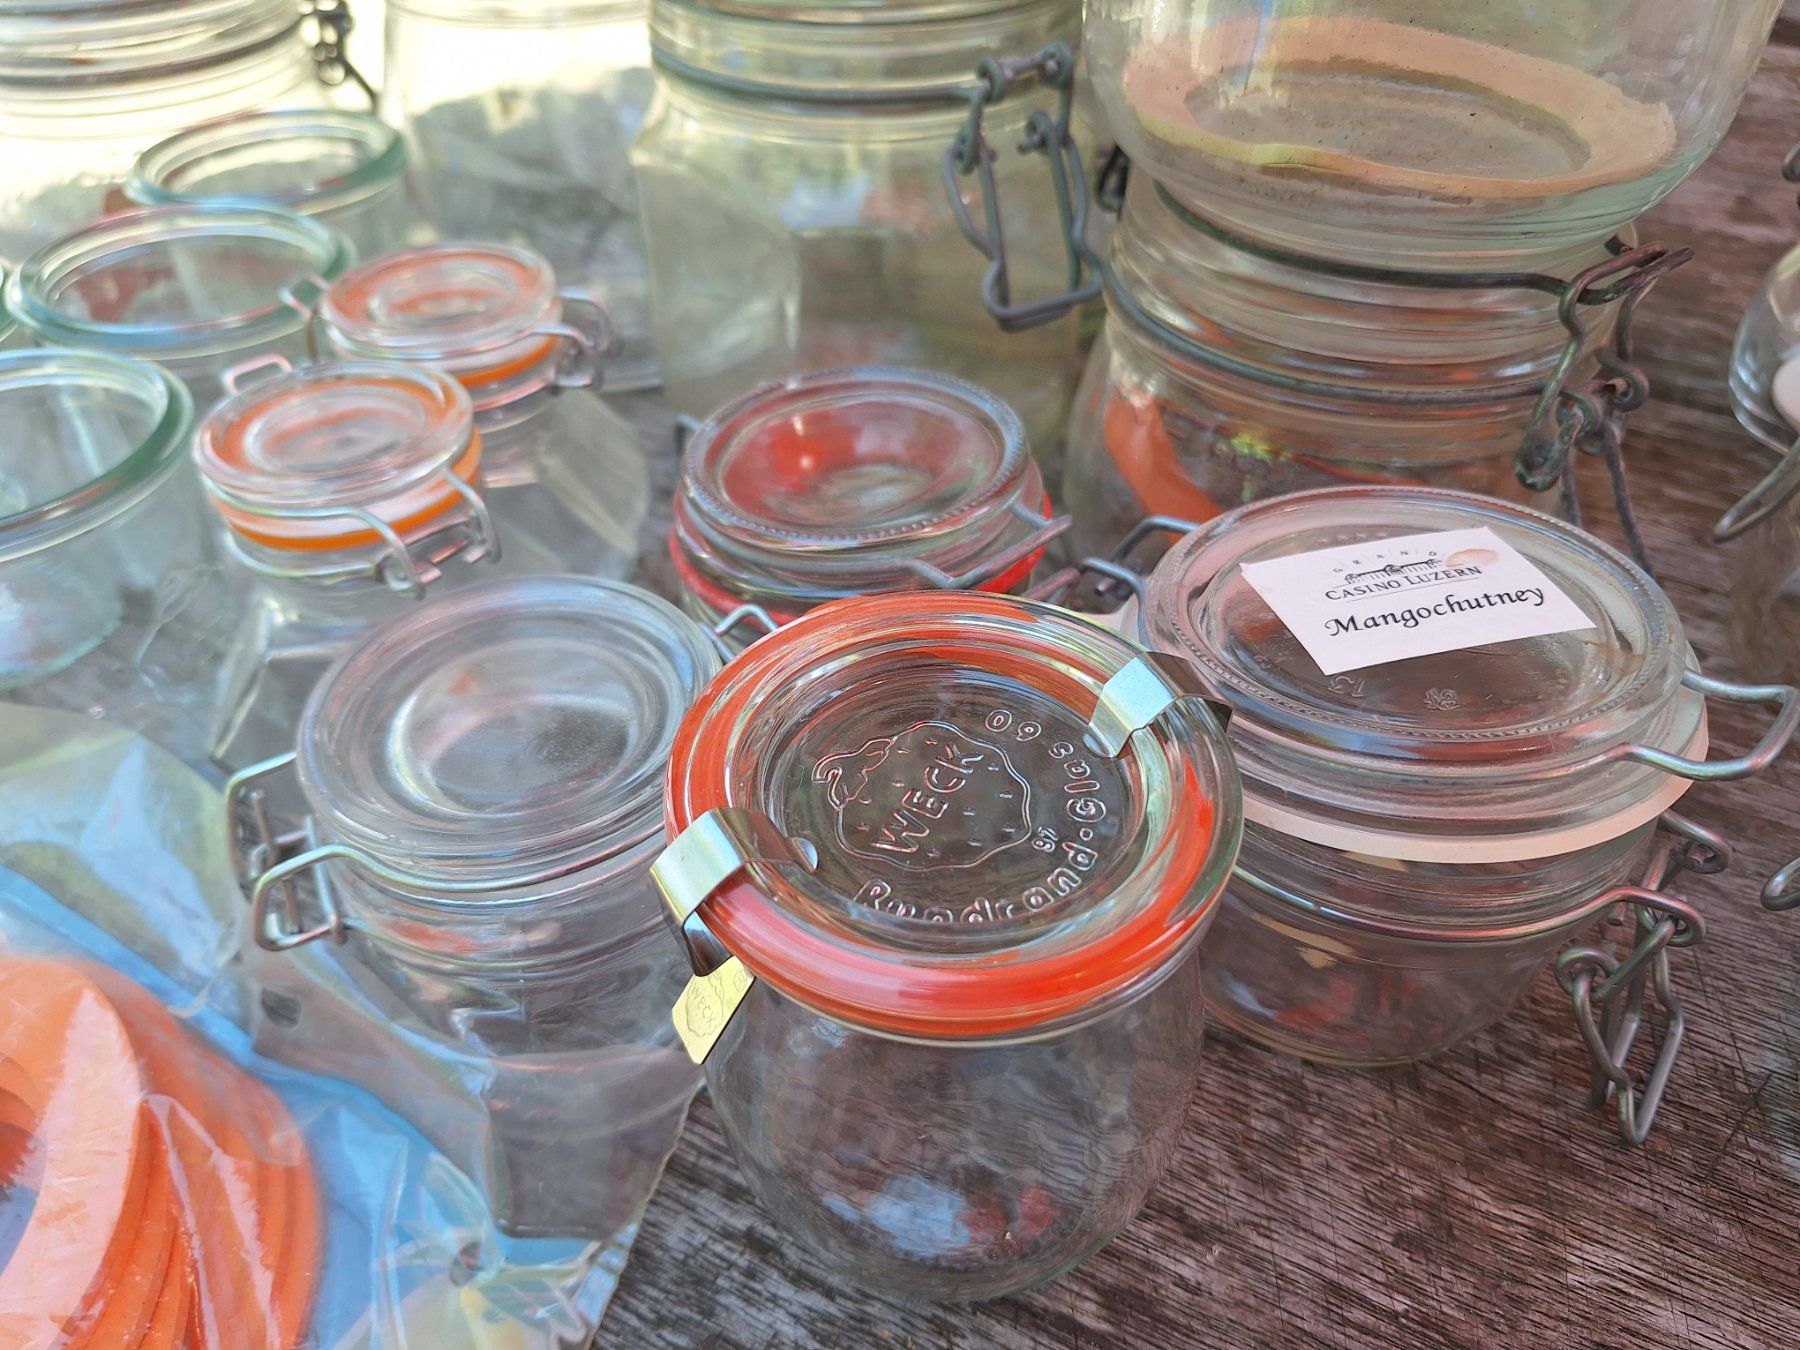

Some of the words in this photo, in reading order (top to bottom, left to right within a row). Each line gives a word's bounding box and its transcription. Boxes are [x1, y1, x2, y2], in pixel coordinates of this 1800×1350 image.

[1324, 577, 1402, 601] CASINO
[1404, 565, 1482, 587] LUZERN
[1324, 586, 1545, 637] Mangochutney
[870, 743, 985, 853] WECK
